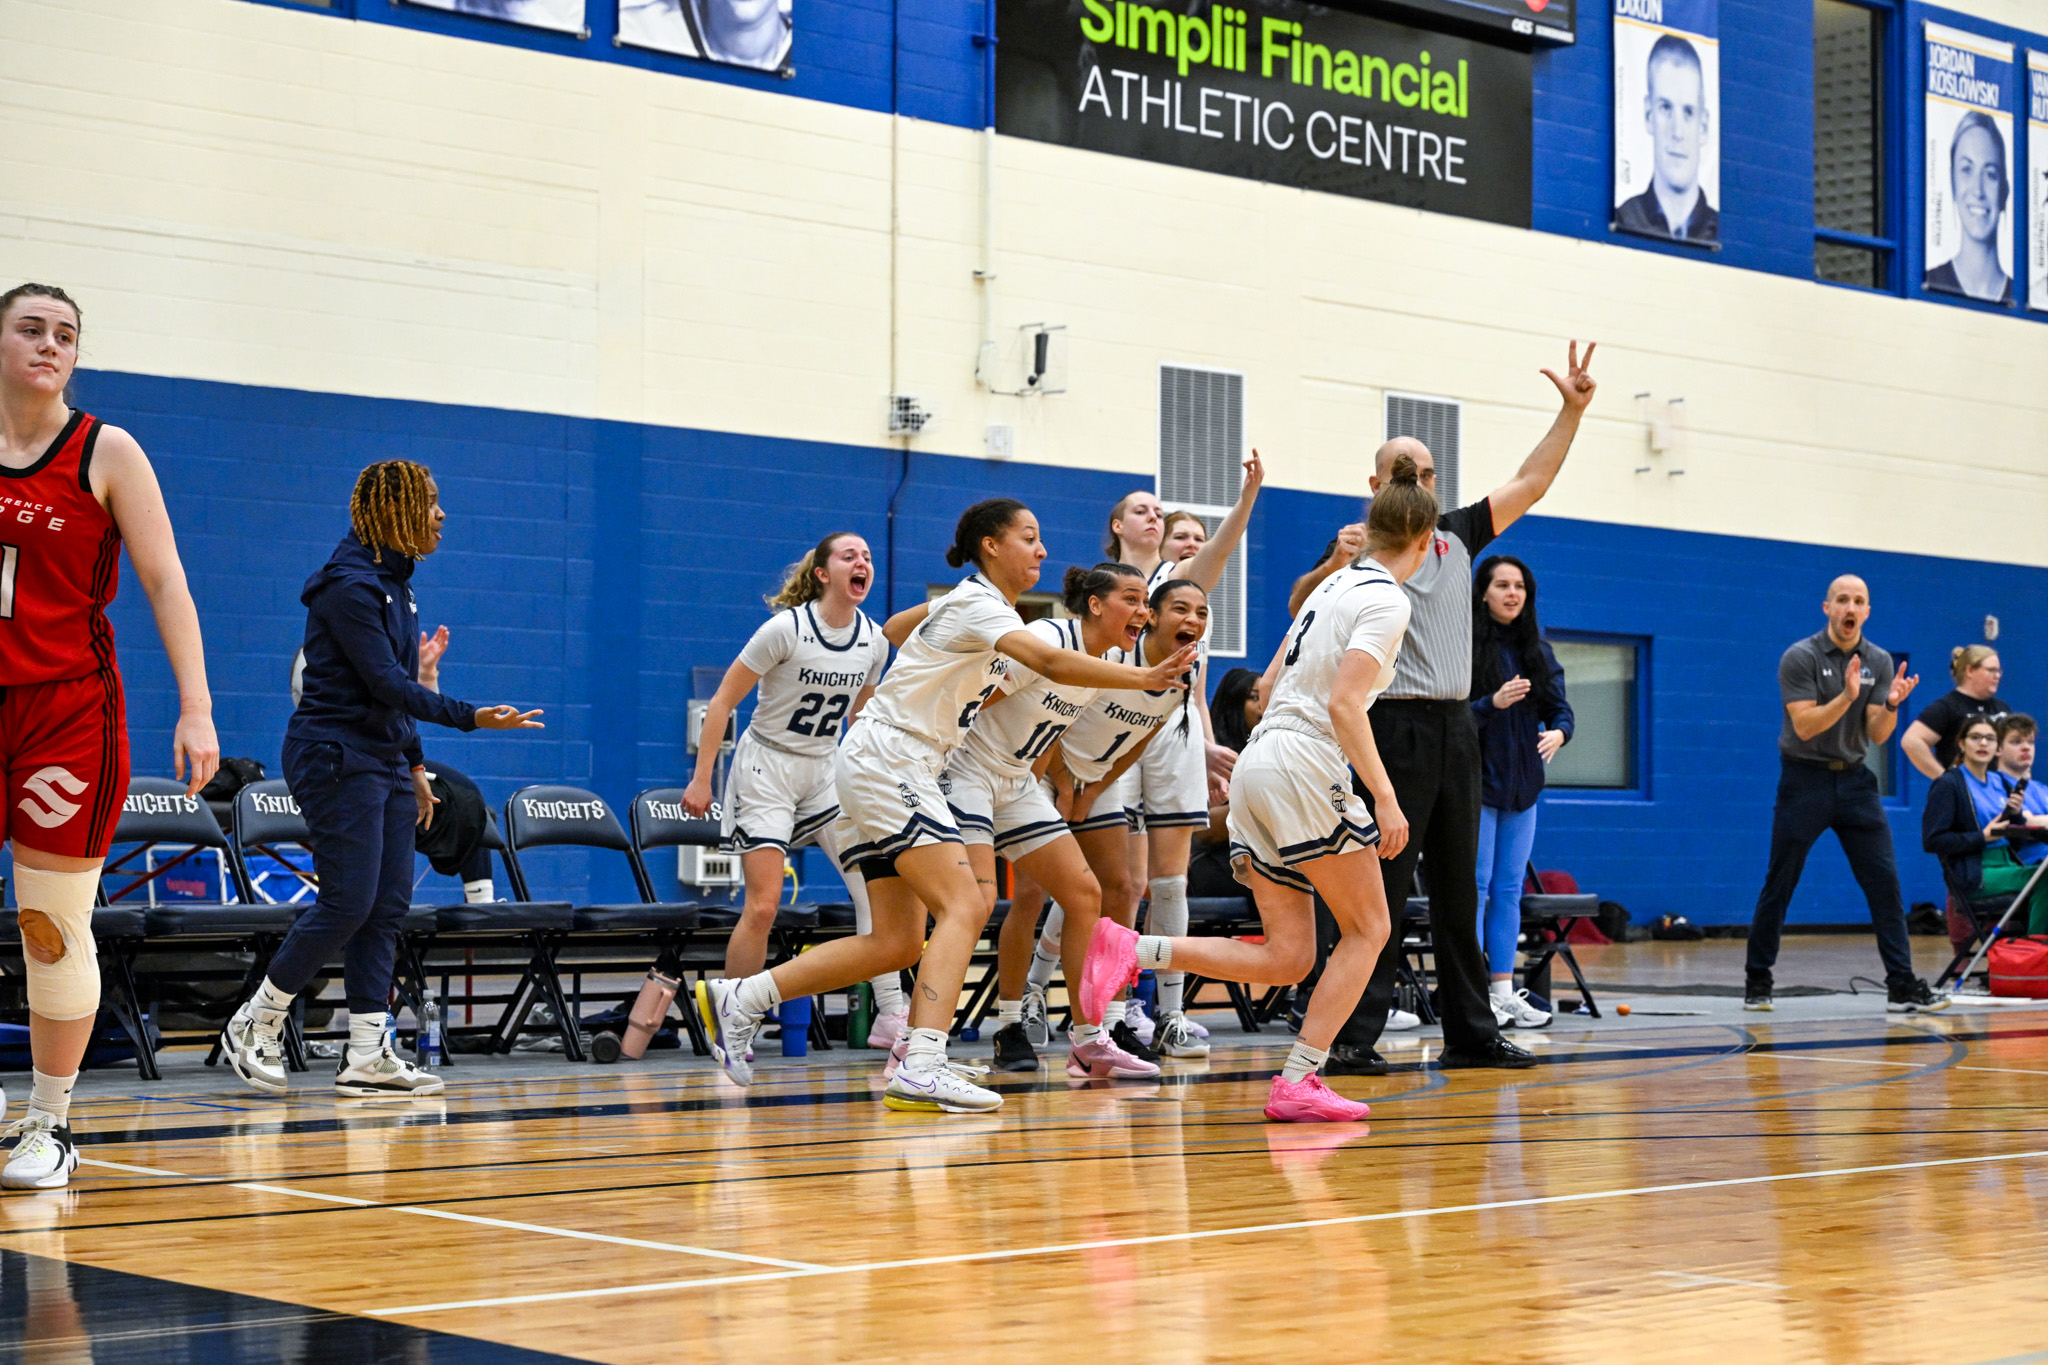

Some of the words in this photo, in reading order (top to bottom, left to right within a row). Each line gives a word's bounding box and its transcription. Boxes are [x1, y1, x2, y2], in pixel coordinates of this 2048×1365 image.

[1079, 0, 1247, 76] Simplii
[1261, 16, 1469, 118] Financial
[1928, 43, 1976, 78] JORDAN
[1929, 68, 2000, 109] KOSLOWSKI
[1078, 65, 1295, 150] ATHLETIC
[1306, 110, 1468, 184] CENTRE
[1284, 610, 1316, 667] 3
[798, 667, 865, 688] KNIGHTS
[786, 692, 851, 738] 22
[1014, 720, 1068, 760] 10
[1092, 731, 1132, 763] 1
[122, 792, 200, 815] NIGHTS
[522, 799, 606, 821] KNIGHTS
